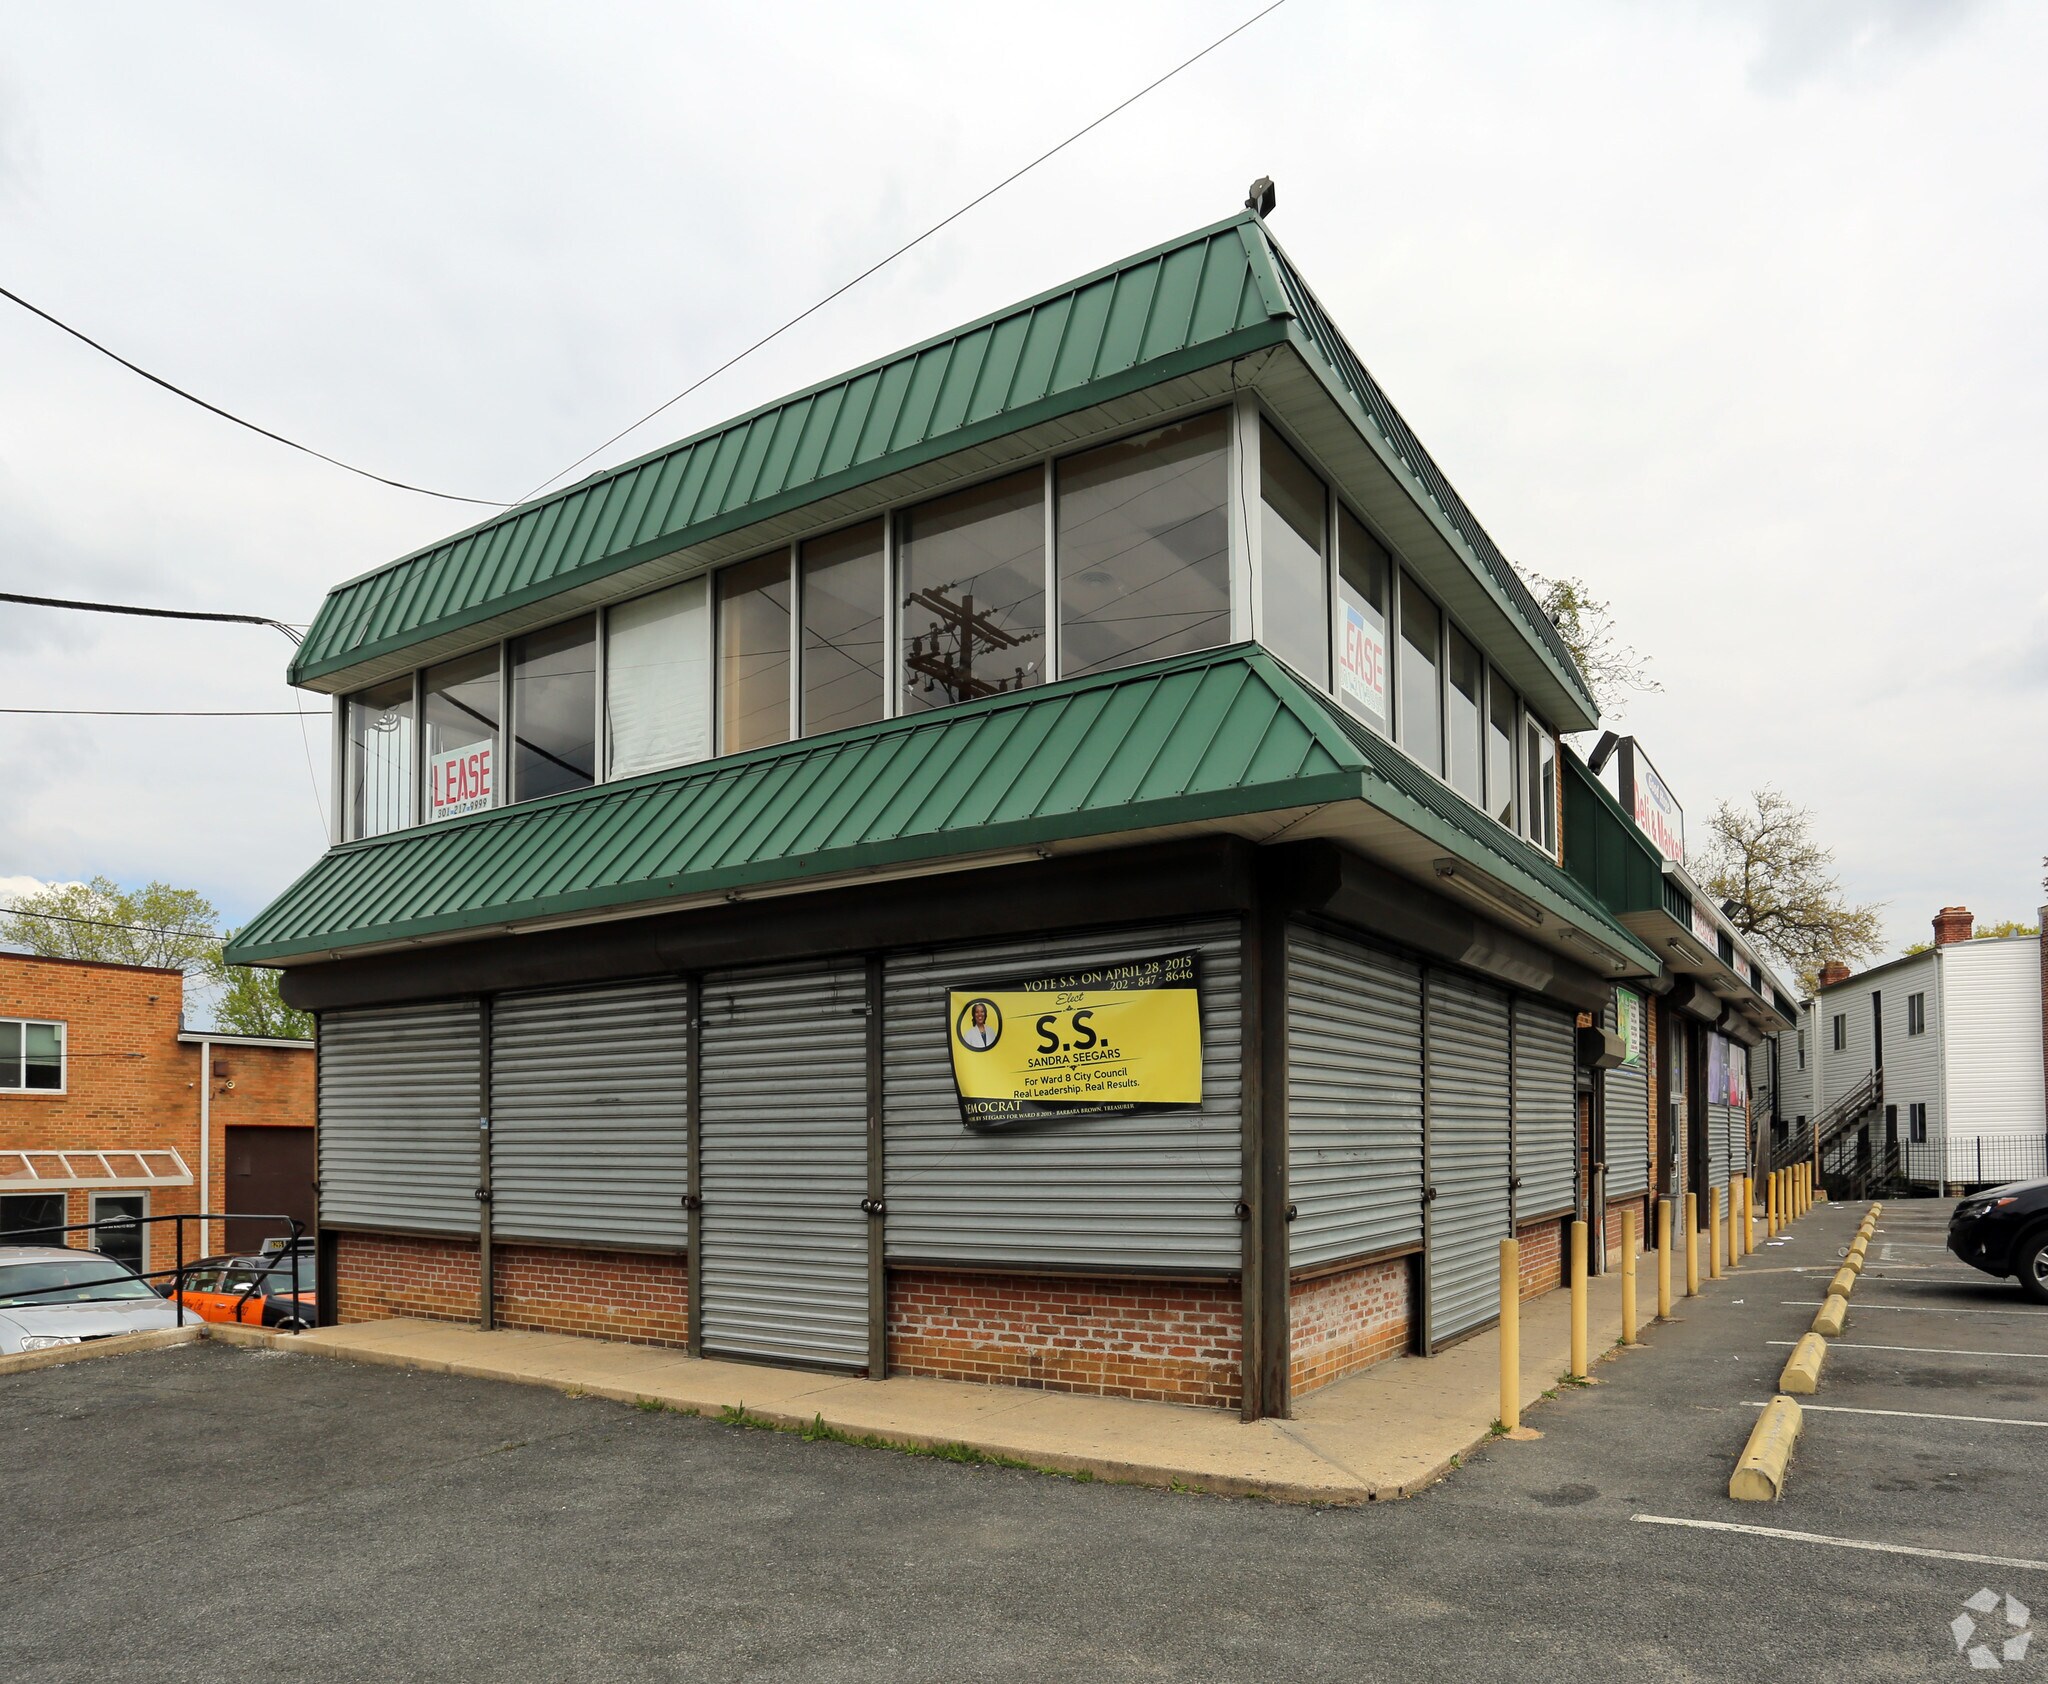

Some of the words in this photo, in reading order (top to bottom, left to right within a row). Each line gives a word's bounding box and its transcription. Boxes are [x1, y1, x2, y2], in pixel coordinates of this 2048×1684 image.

[433, 751, 490, 807] LEASE
[1634, 780, 1651, 836] Deli
[1657, 810, 1683, 863] Market
[1023, 978, 1057, 993] VOTE
[1059, 975, 1079, 988] S.S.
[1081, 971, 1102, 985] ON
[1105, 965, 1142, 981] APRIL
[1164, 955, 1192, 971] 2015
[1109, 979, 1129, 991] 202
[1137, 974, 1157, 987] 847
[1165, 969, 1194, 982] 8646
[1055, 991, 1085, 1006] Elect
[1036, 1010, 1109, 1054] S.S.
[1027, 1054, 1071, 1068] SANDRA
[1073, 1048, 1121, 1063] SEEGARS
[1024, 1077, 1038, 1087] For
[1040, 1074, 1063, 1085] Ward
[1065, 1073, 1072, 1082] 8
[1073, 1072, 1092, 1082] City
[1094, 1067, 1128, 1079] Council
[1013, 1088, 1032, 1099] Real
[1033, 1084, 1084, 1097] Leadership.
[1085, 1081, 1105, 1092] Real
[1107, 1078, 1140, 1090] Results.
[1056, 1108, 1080, 1116] BARBARA
[1104, 1103, 1135, 1112] TREASURER
